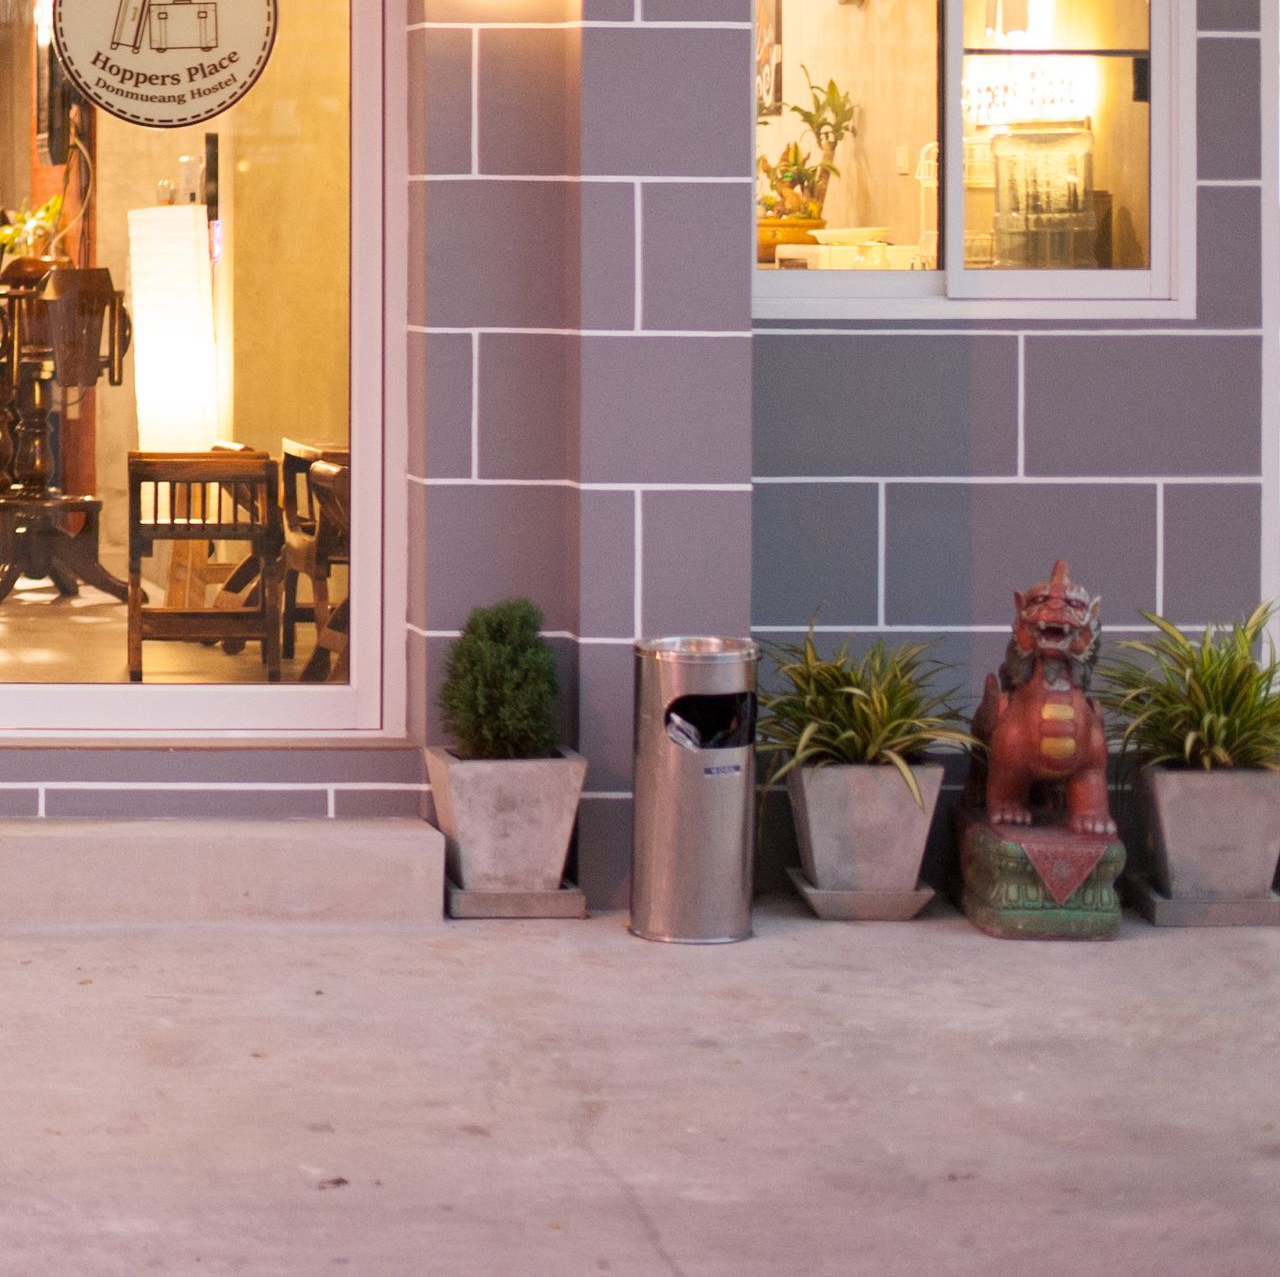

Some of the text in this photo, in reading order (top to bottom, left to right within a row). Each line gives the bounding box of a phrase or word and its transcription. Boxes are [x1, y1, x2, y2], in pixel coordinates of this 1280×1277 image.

[91, 50, 240, 88] Hoppers Place
[94, 73, 238, 105] Donmueang Hostel
